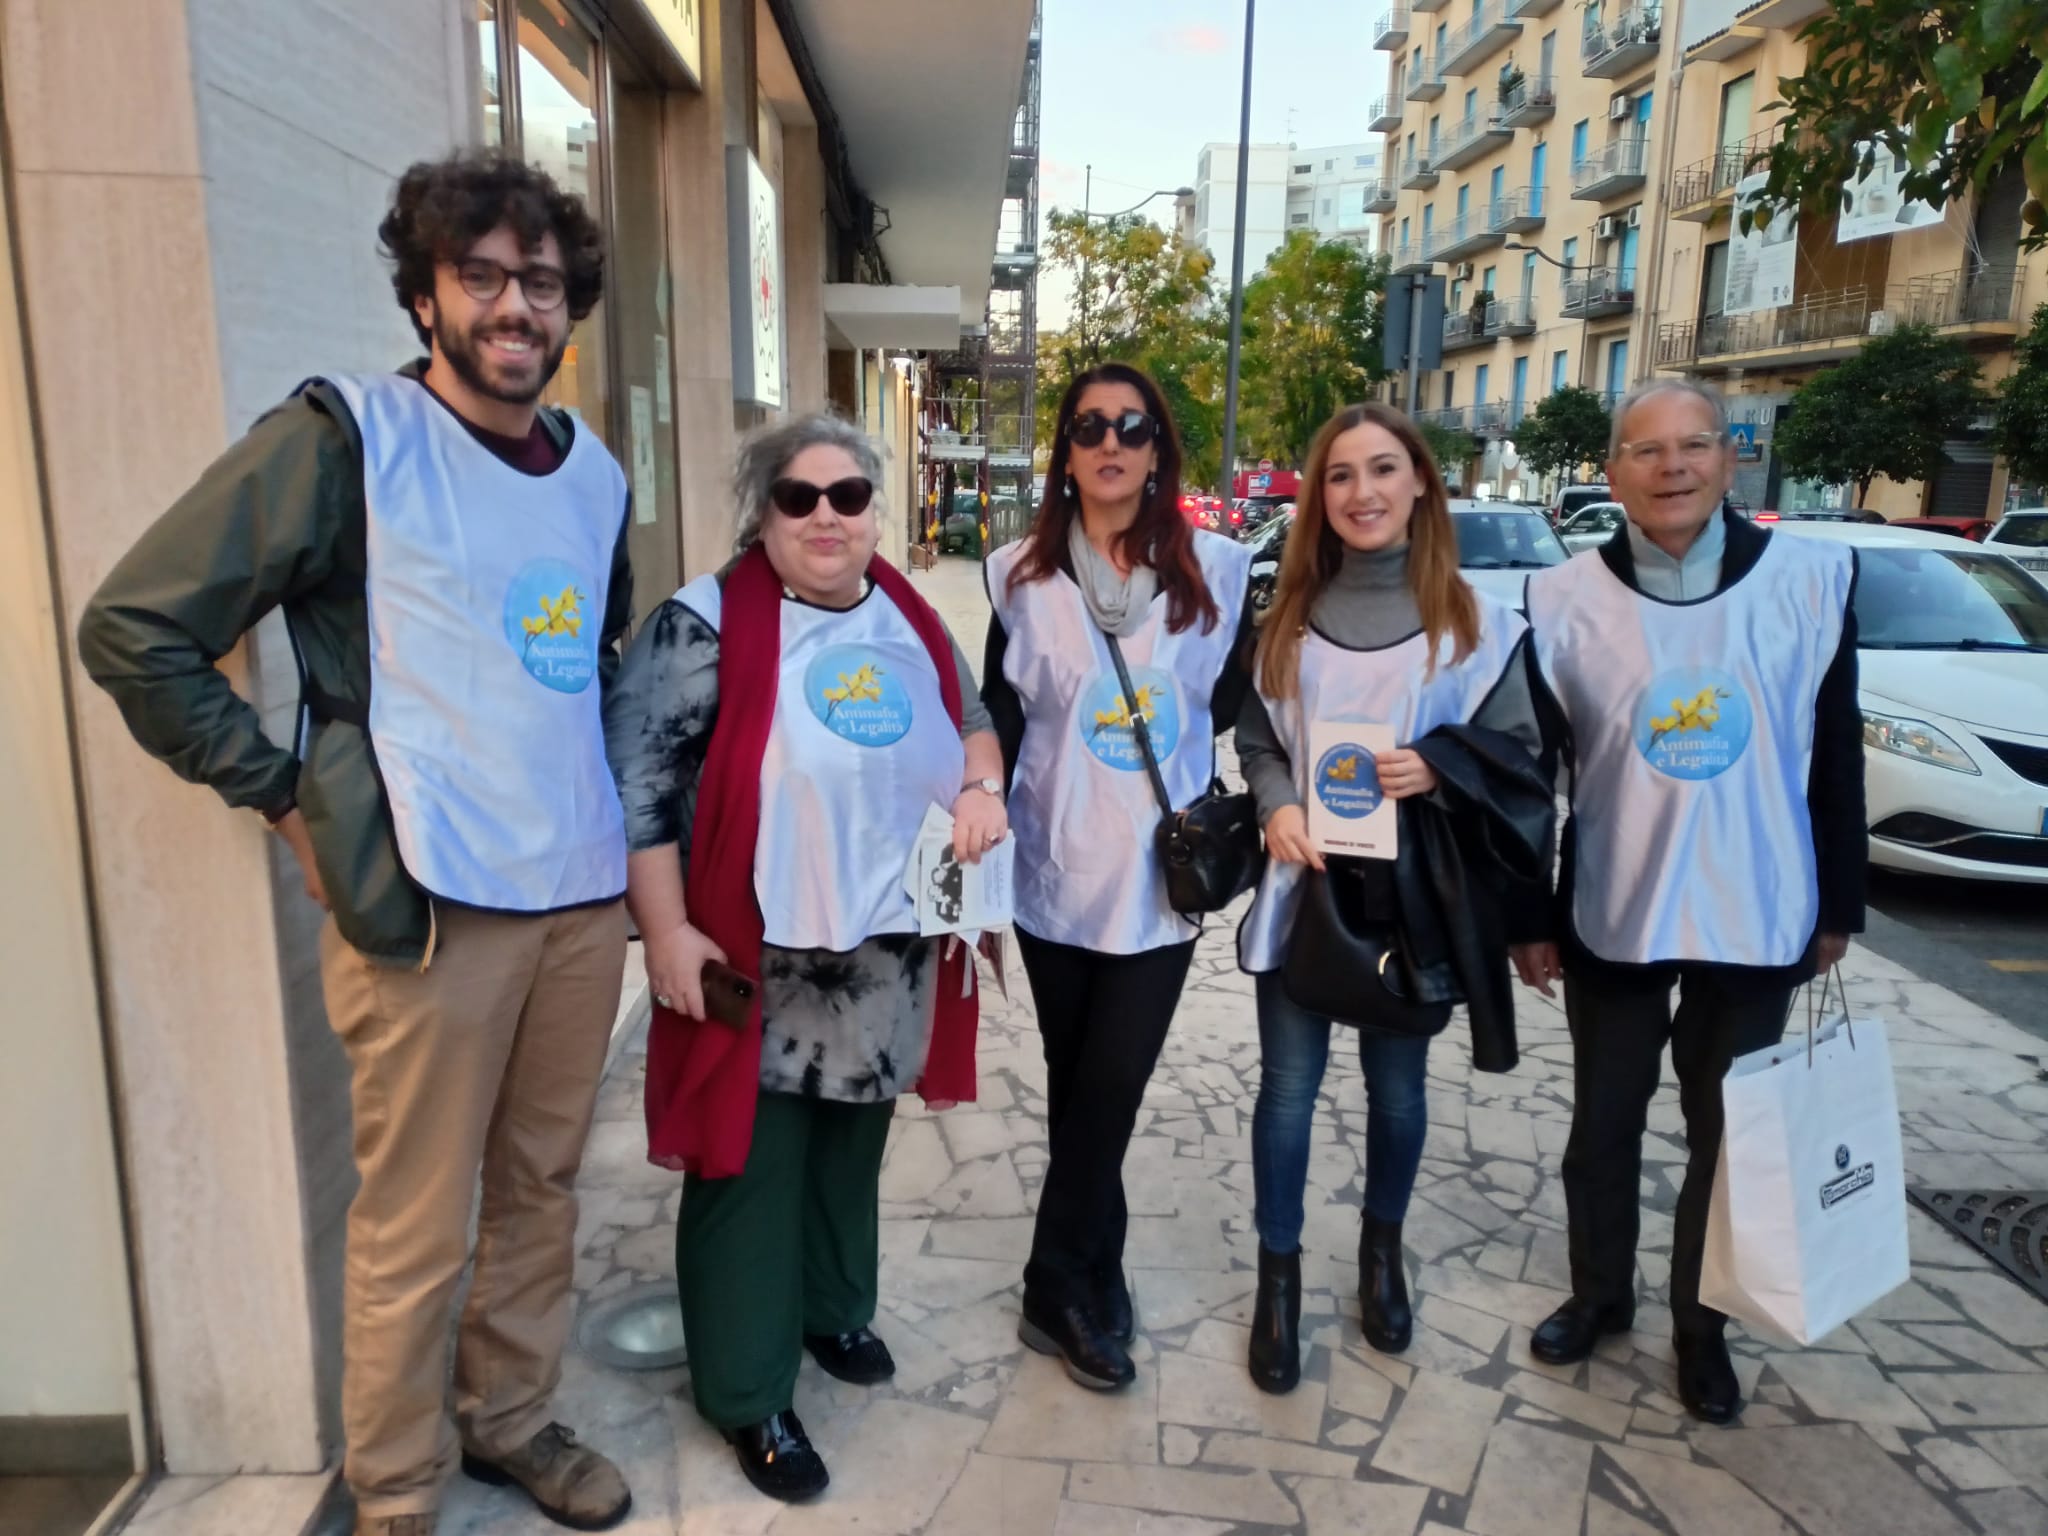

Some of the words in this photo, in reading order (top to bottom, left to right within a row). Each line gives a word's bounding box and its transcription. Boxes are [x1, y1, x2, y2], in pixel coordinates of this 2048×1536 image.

[834, 705, 899, 719] Antimafia
[837, 724, 848, 735] e
[1655, 736, 1729, 752] Antimafia
[1097, 748, 1105, 757] e
[1656, 758, 1665, 768] e
[1670, 752, 1729, 770] Legalità
